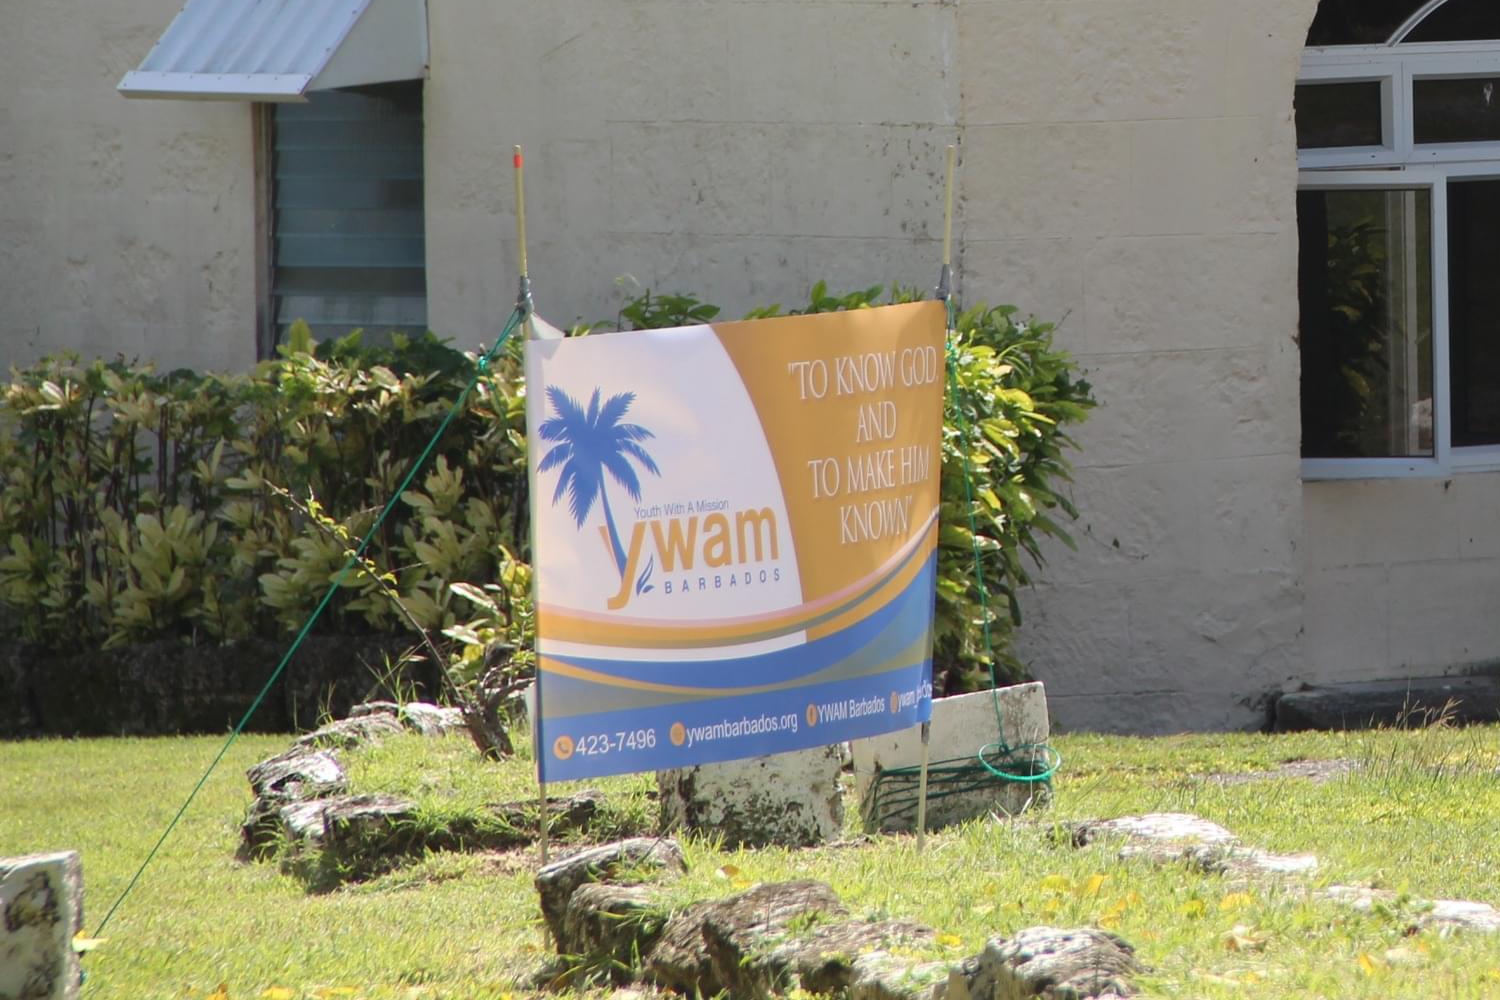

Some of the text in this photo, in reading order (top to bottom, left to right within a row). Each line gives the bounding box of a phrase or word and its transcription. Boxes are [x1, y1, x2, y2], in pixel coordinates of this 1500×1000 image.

[835, 350, 896, 396] KNOW
[856, 401, 897, 443] AND
[808, 445, 930, 498] TO MAKE HIM
[634, 499, 730, 520] Youth With A Mission
[598, 506, 780, 610] ywam
[664, 567, 781, 595] BARBADOS
[816, 696, 885, 724] YWAM Barbados
[575, 728, 657, 756] 423-7496
[686, 713, 799, 748] ywambarbados.org
